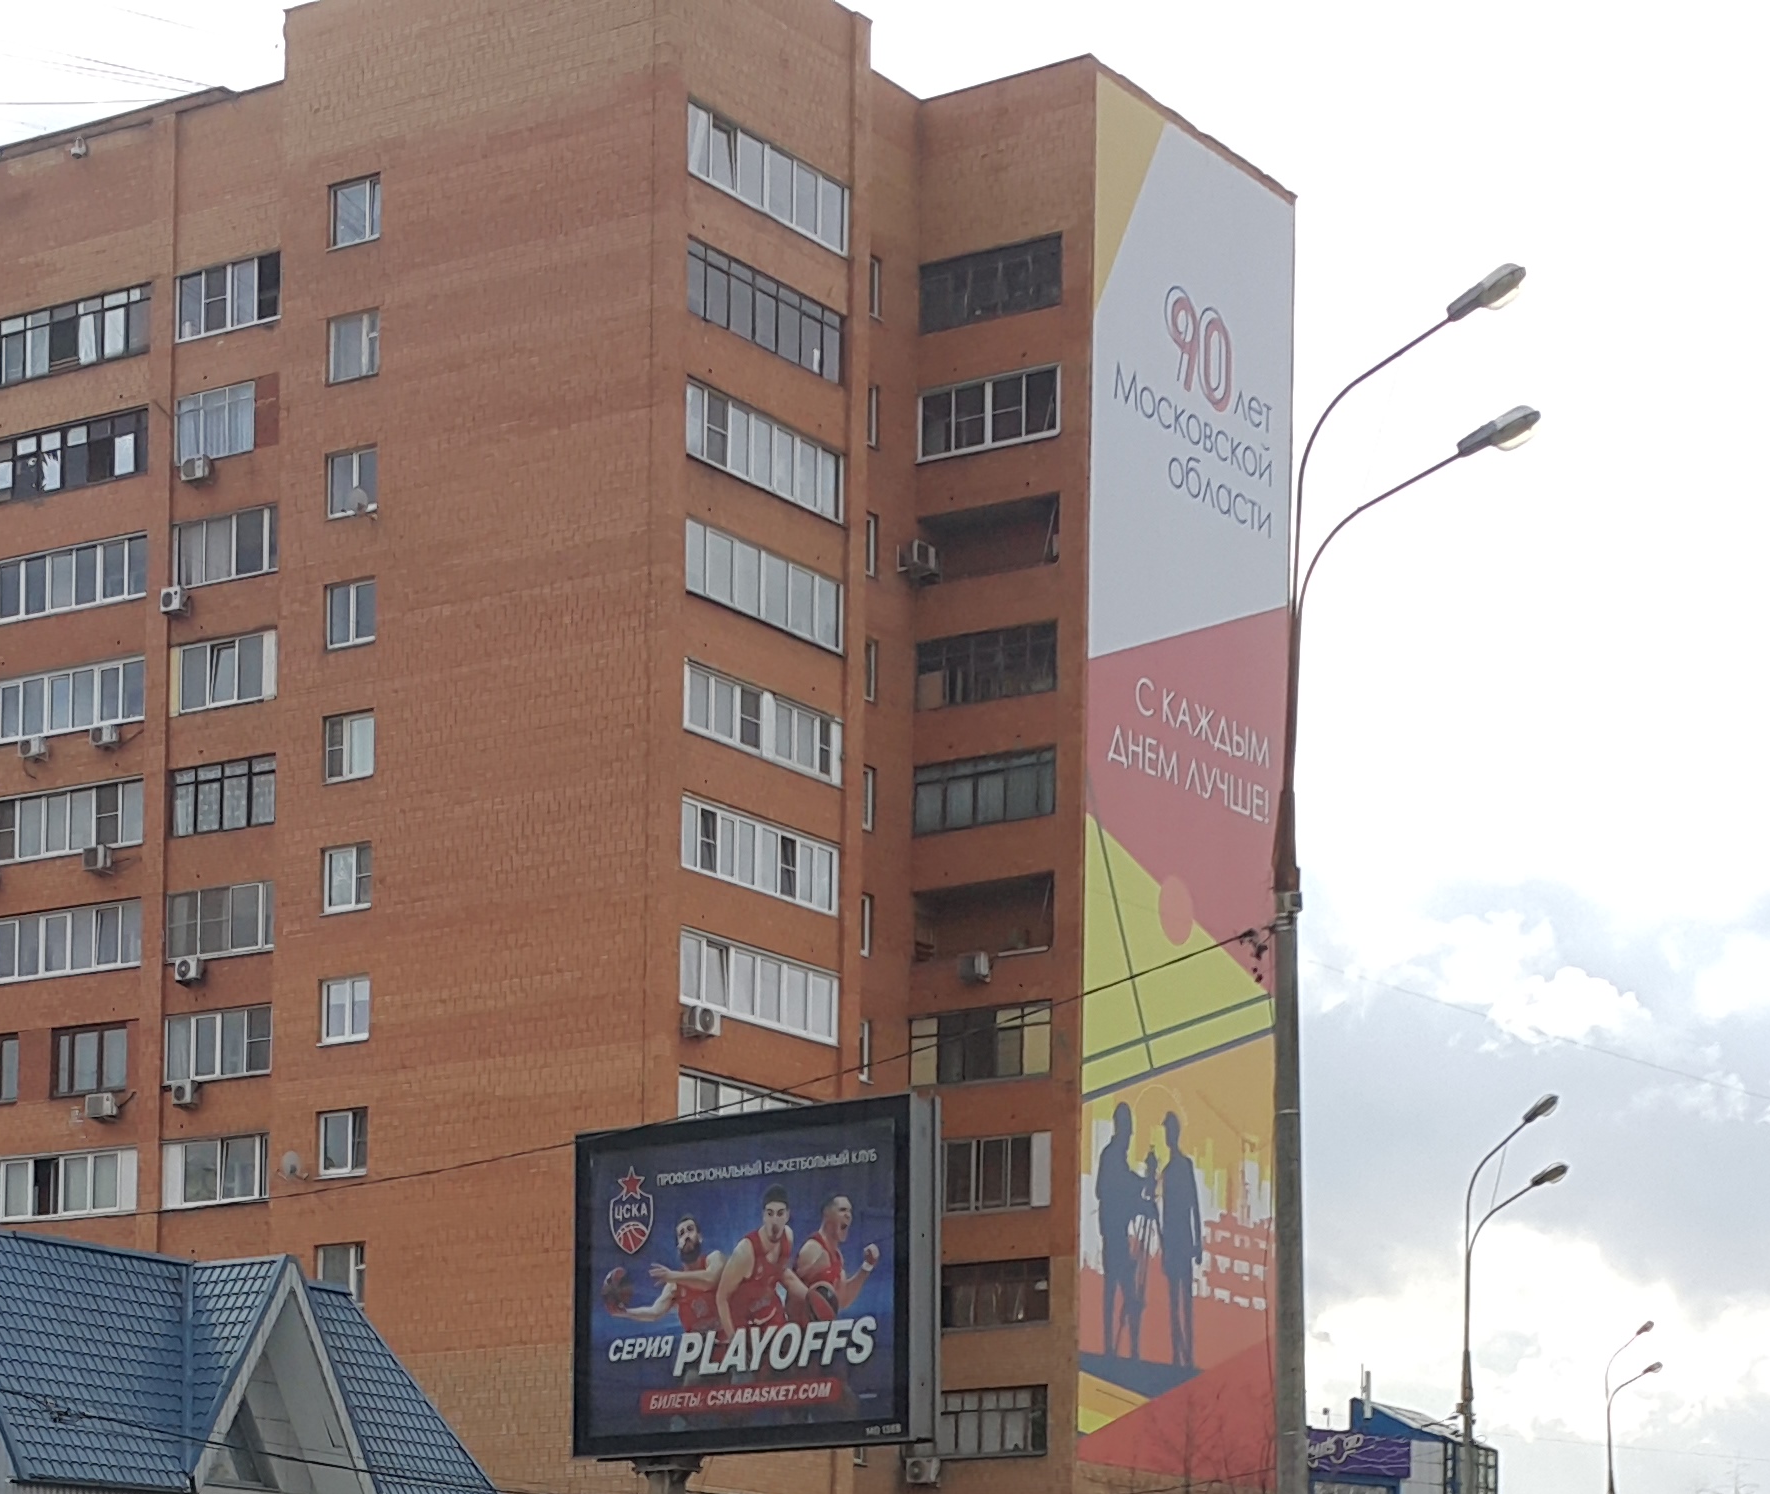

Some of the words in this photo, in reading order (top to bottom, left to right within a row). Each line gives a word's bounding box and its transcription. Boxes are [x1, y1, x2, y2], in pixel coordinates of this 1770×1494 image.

[1164, 285, 1232, 413] 90
[1234, 390, 1273, 434] лет
[1114, 360, 1273, 488] Московской
[1168, 456, 1273, 539] области
[1135, 677, 1155, 717] С
[1162, 687, 1270, 769] КАЖДЫМ
[1107, 724, 1179, 785] ДНЕМ
[1184, 757, 1270, 825] ЛУЧШЕ!
[656, 1159, 763, 1187] ПРОФЕССИОНАЛЬНЫЙ
[764, 1148, 850, 1175] БАСКЕТБОЛЬНЫЙ
[614, 1202, 648, 1222] ЦСКА
[608, 1334, 674, 1362] СЕРИЯ
[672, 1315, 877, 1377] PLAYOFFS
[707, 1382, 832, 1406] CSKABASKET.COM
